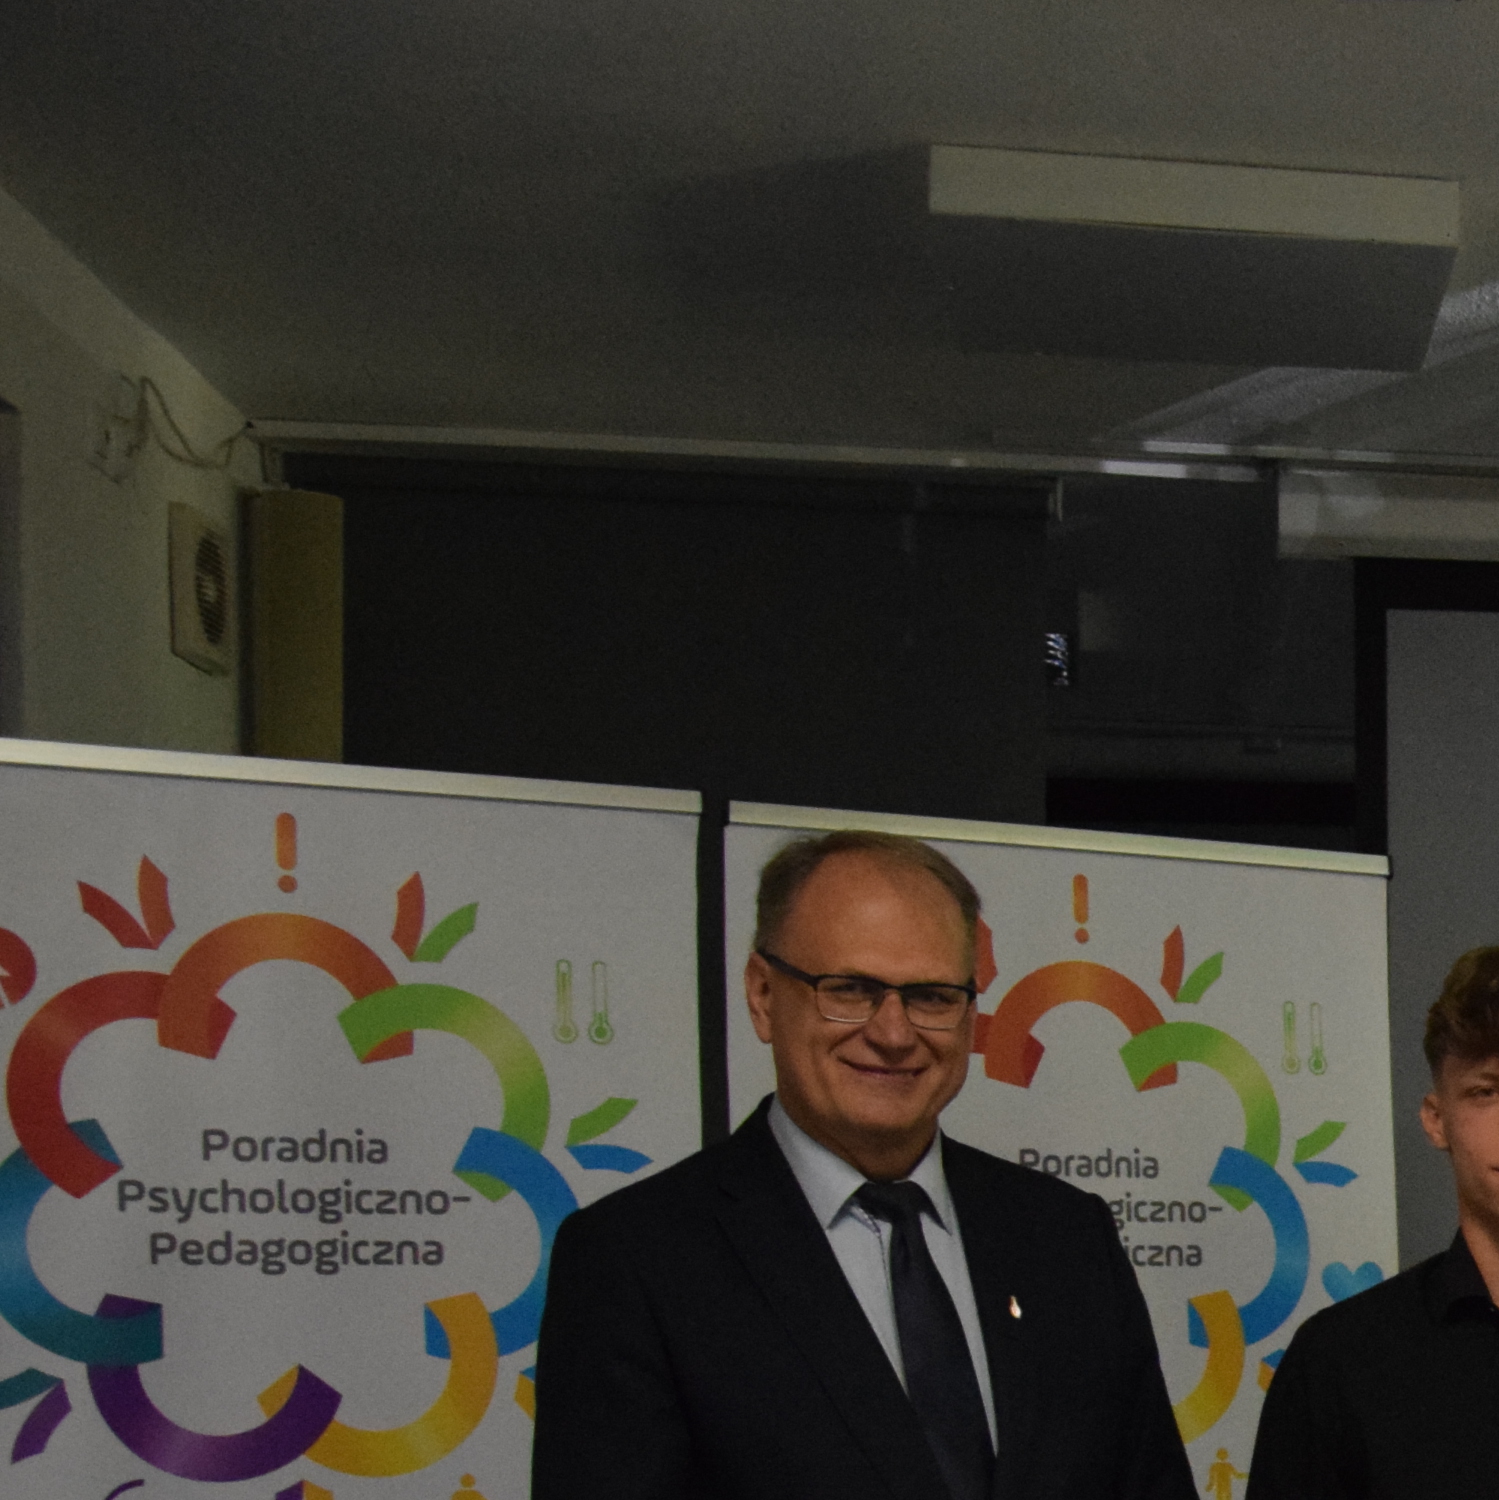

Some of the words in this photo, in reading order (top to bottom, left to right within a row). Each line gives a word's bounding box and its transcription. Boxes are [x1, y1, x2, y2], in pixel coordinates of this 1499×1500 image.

[200, 1128, 389, 1165] Poradnia
[116, 1178, 471, 1222] Psychologiczno-
[148, 1231, 444, 1275] Pedagogiczna
